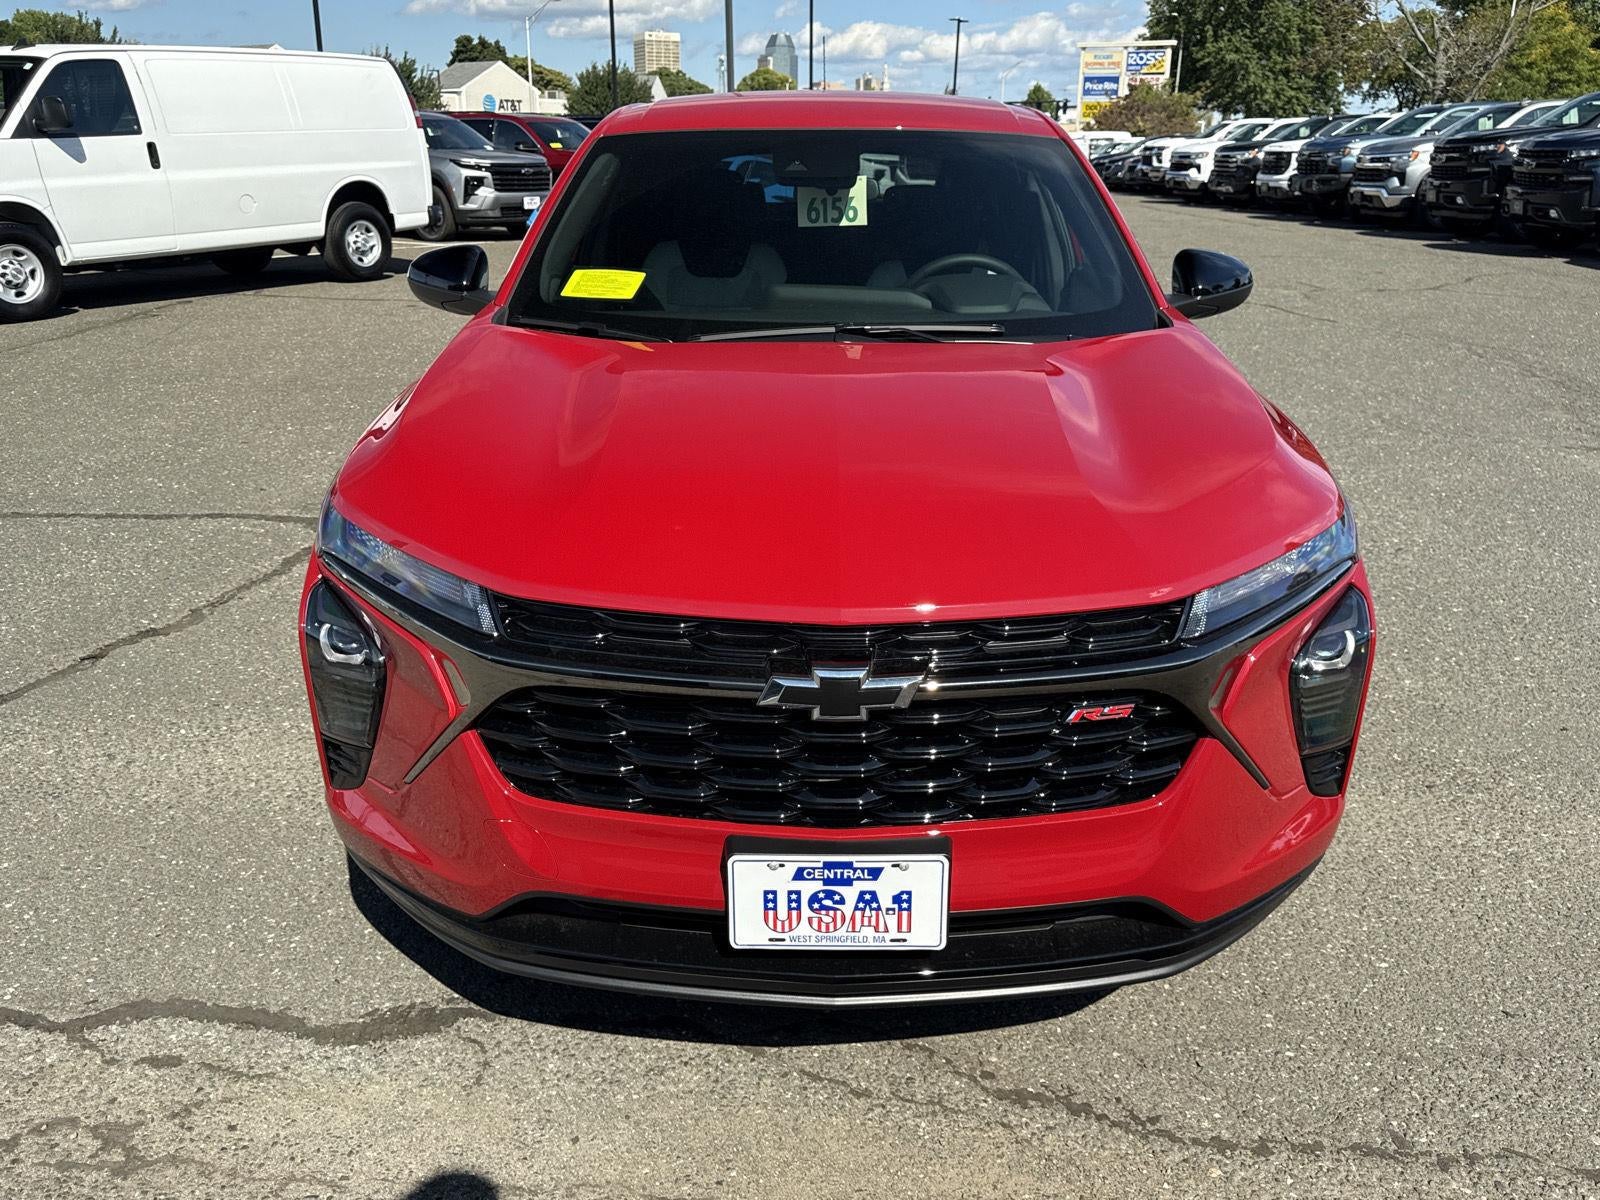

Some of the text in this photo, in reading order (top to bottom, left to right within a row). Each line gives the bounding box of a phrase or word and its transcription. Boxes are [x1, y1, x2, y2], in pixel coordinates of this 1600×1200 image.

[1084, 81, 1118, 91] Price Rite
[498, 99, 522, 112] AT&T
[806, 196, 859, 225] 6156
[1065, 703, 1136, 723] RS
[803, 867, 873, 880] CENTRAL
[789, 934, 812, 944] WEST
[872, 935, 887, 944] MA
